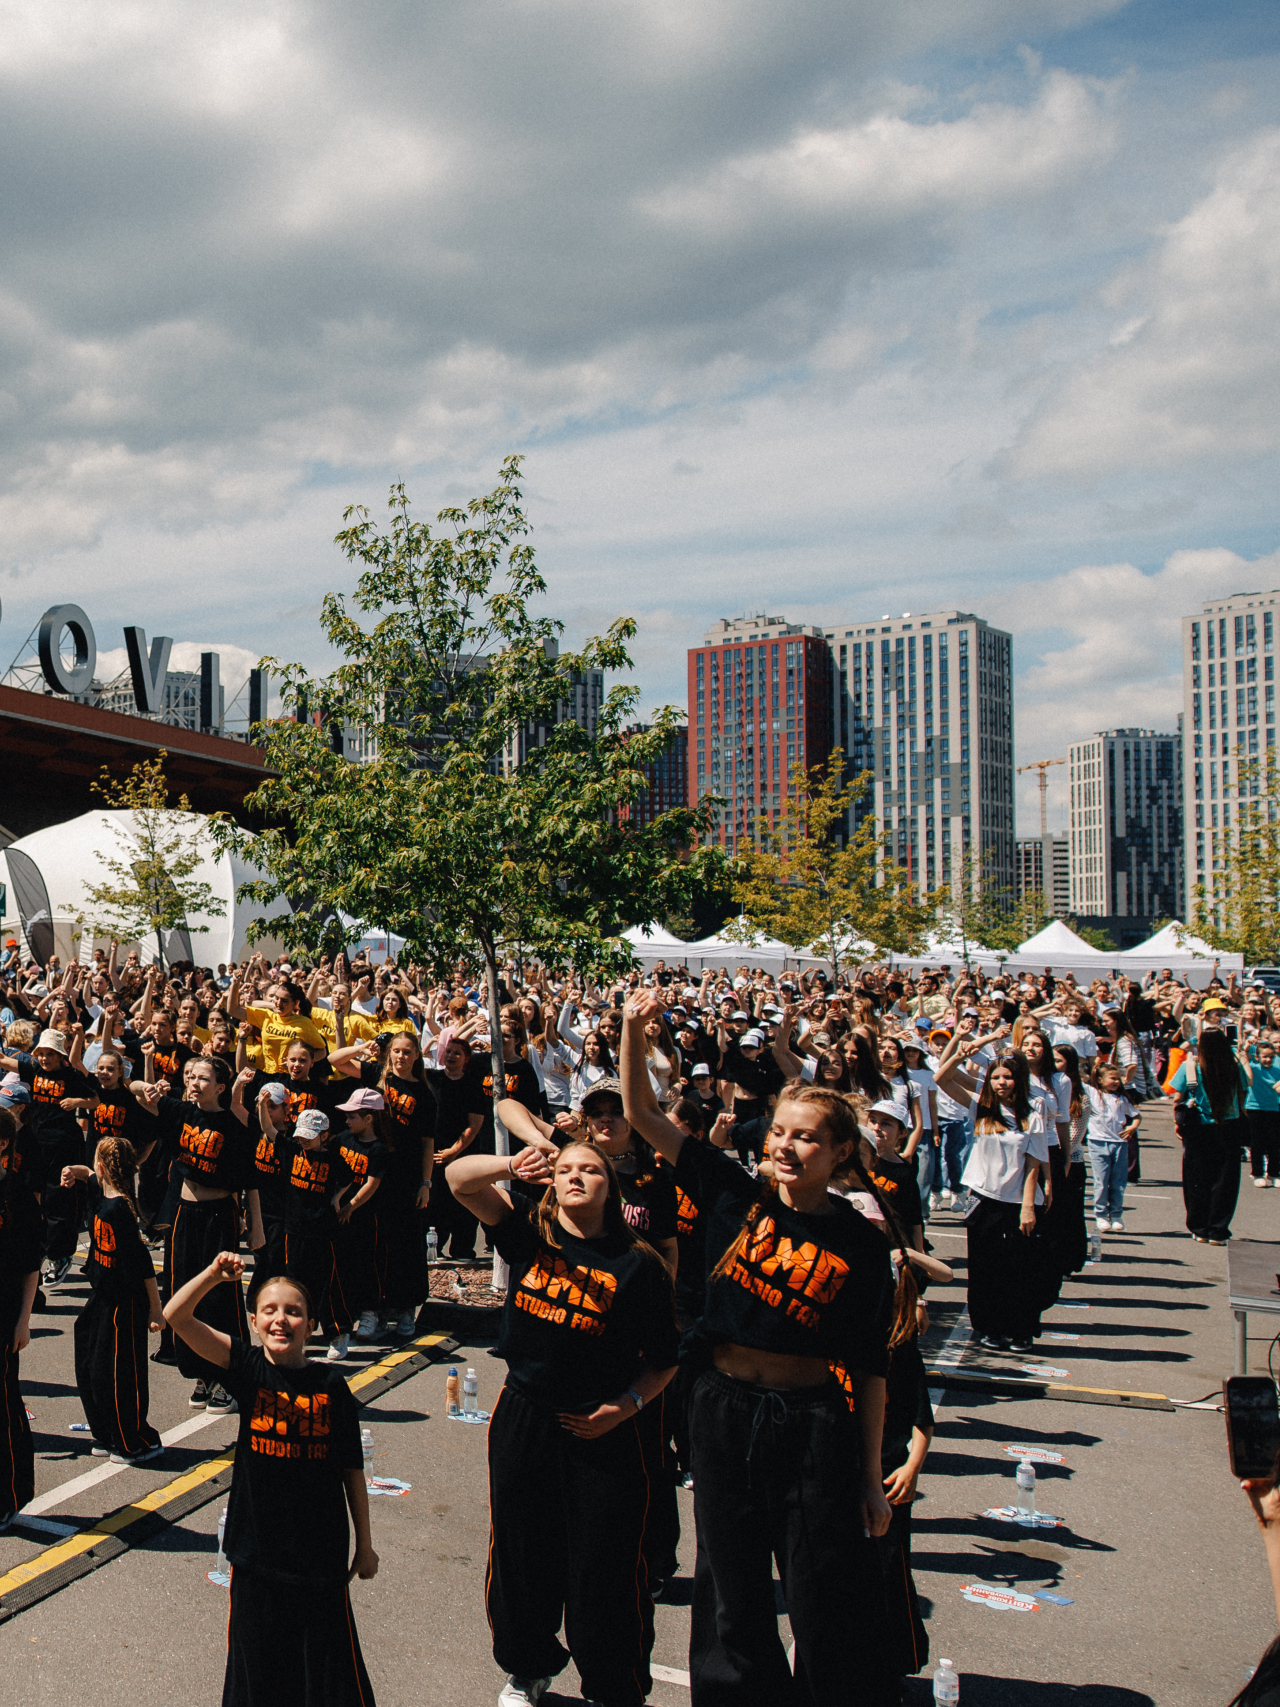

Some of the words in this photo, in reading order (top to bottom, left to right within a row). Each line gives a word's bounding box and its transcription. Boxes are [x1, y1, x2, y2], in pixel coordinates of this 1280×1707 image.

[289, 1092, 319, 1113] MD
[179, 1122, 225, 1159] DMD
[198, 1159, 218, 1173] FAM
[291, 1154, 330, 1183] DMD
[738, 1215, 851, 1304] DMD
[520, 1249, 618, 1314] DMD
[514, 1290, 568, 1325] STUDIO
[570, 1312, 607, 1337] FAM
[785, 1298, 821, 1333] FAM
[250, 1388, 333, 1437] DMD
[251, 1434, 301, 1459] STUDIO
[307, 1443, 332, 1460] FAM
